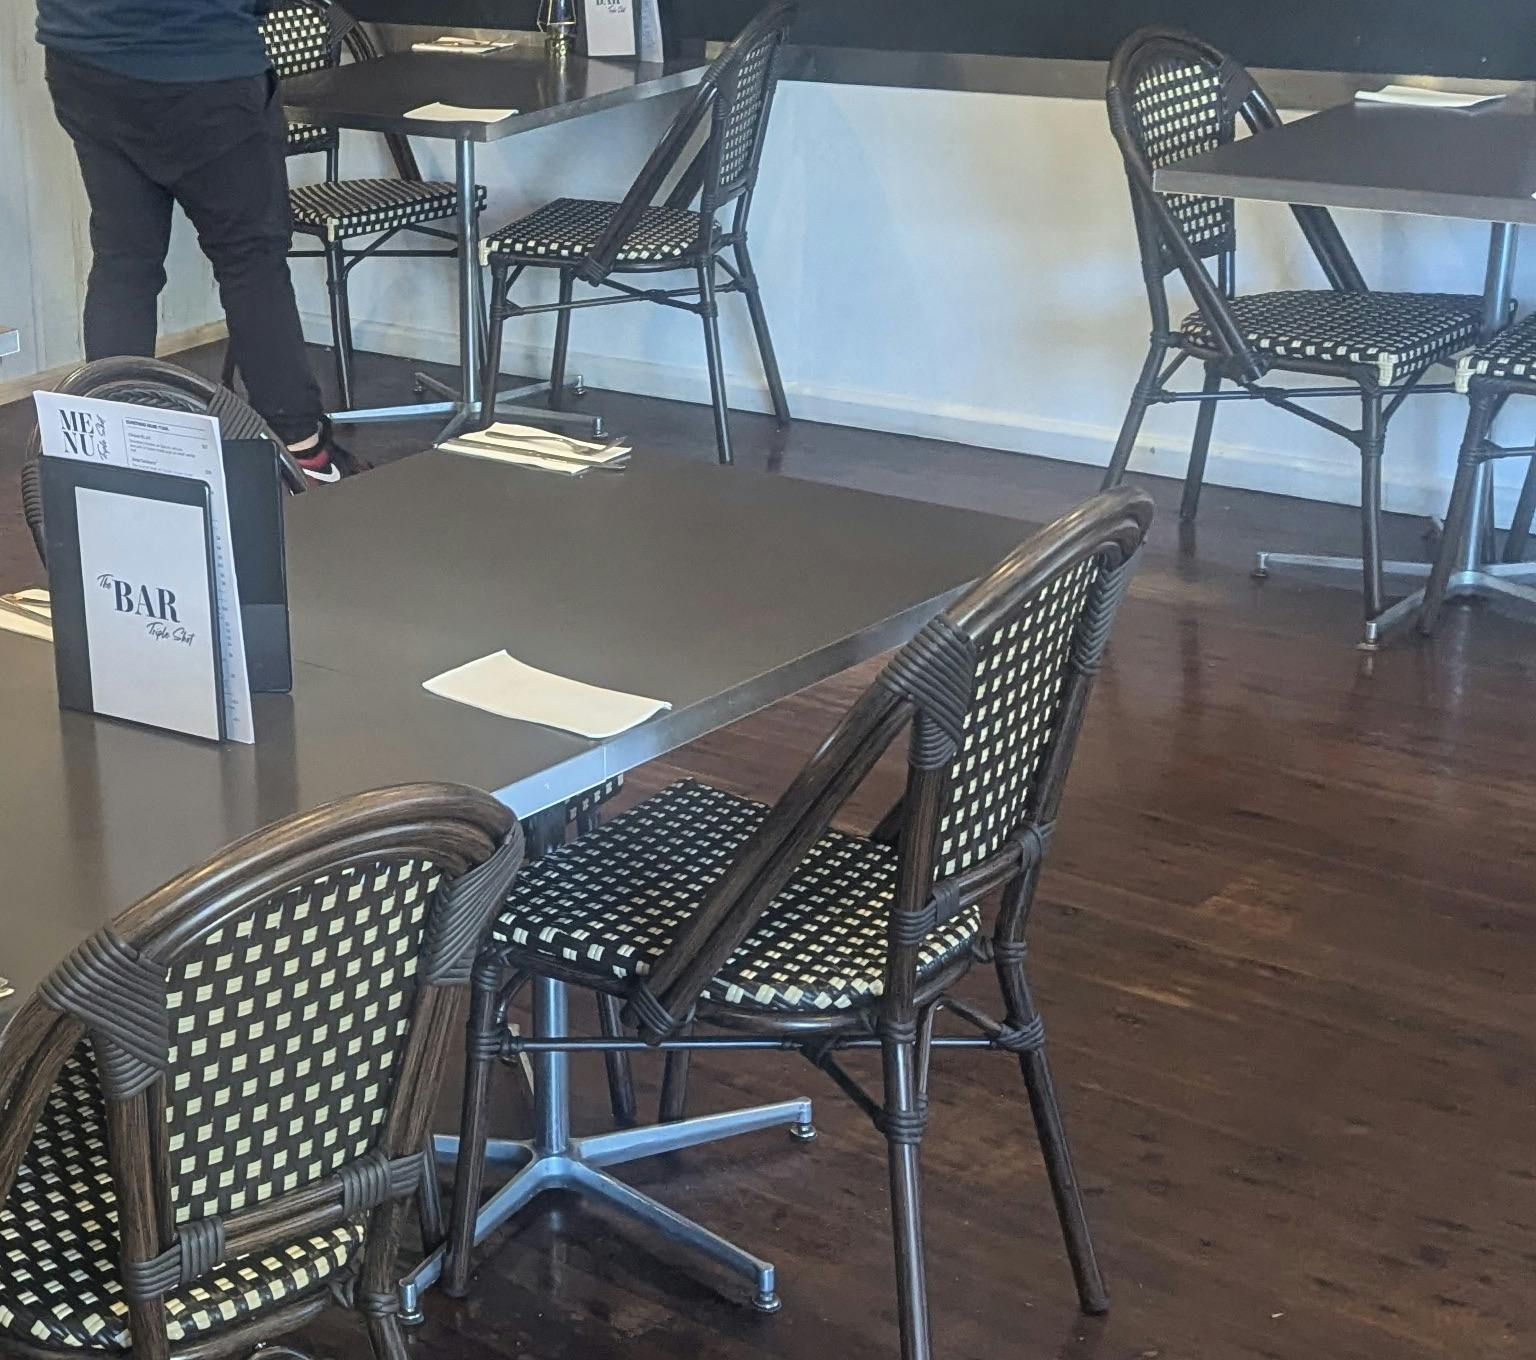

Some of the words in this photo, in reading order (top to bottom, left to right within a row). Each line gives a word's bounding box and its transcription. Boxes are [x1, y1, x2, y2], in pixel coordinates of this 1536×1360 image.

[58, 409, 94, 434] ME
[63, 430, 95, 456] NU
[97, 574, 114, 589] The
[112, 579, 180, 623] BAR
[146, 622, 170, 640] Triple
[172, 627, 195, 646] Shot
